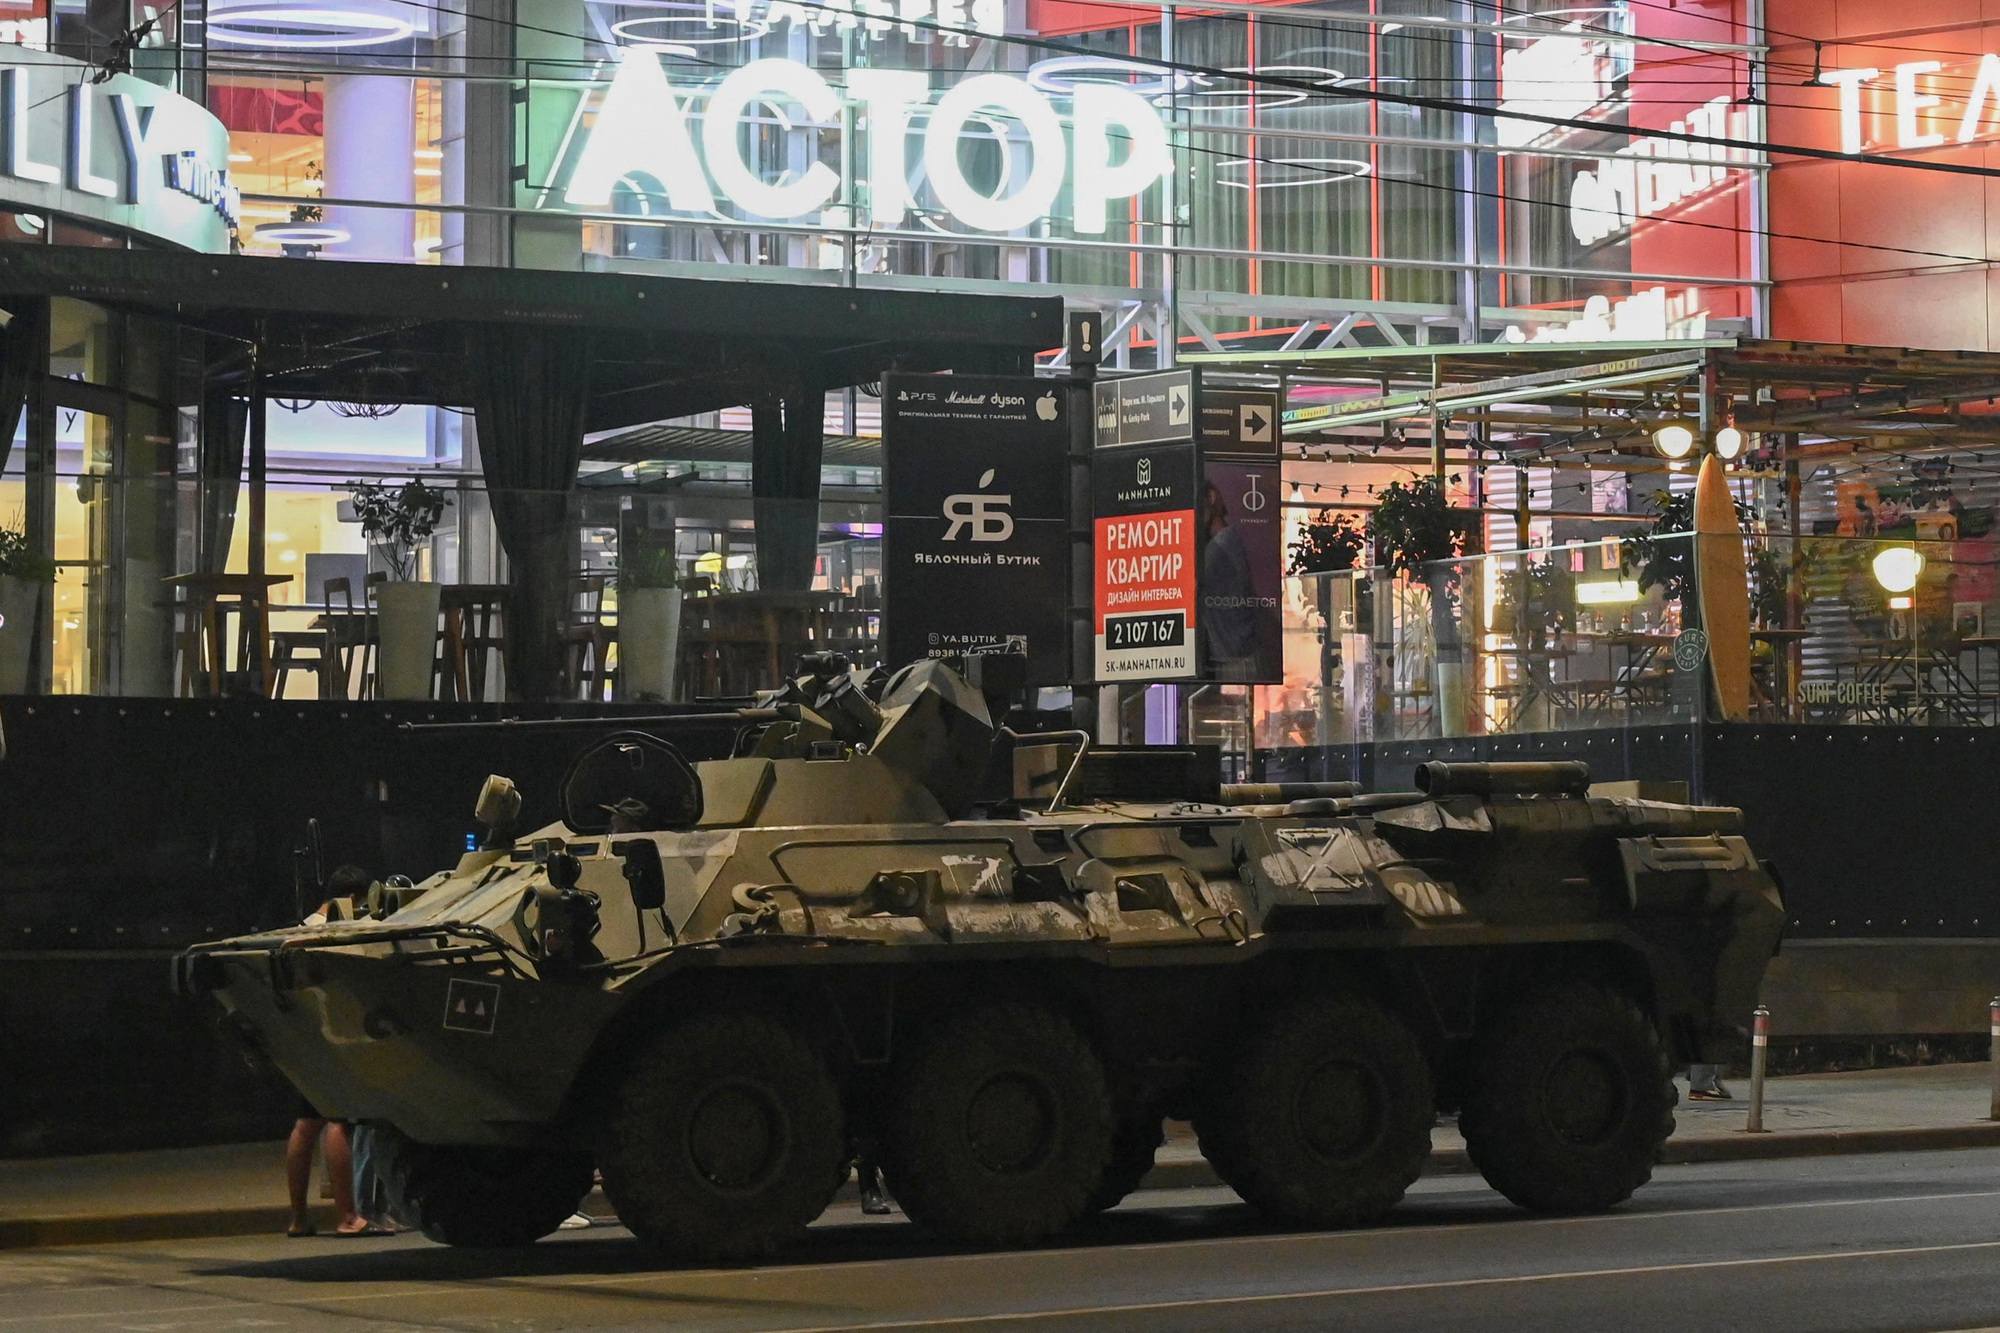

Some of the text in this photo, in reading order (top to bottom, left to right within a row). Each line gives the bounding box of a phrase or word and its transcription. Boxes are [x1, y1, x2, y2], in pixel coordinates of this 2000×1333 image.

[564, 45, 1173, 234] АСТОР
[911, 390, 1026, 408] PS5 Marshall dyson
[1118, 486, 1171, 501] MANHATTAN
[941, 493, 1015, 542] ЯБ
[1107, 518, 1182, 550] РЕМОНТ
[1107, 553, 1183, 585] КВАРТИР
[1107, 587, 1183, 606] ДИЗАЙН ИНТЕРЬЕРА
[1204, 595, 1277, 608] СОЗДАЕТСЯ
[942, 634, 998, 643] YA.BUTIK
[1114, 619, 1175, 644] 2 107 167
[1105, 657, 1185, 673] SK-MANHATTAN.RU
[1797, 681, 1889, 705] SURF COFFEE
